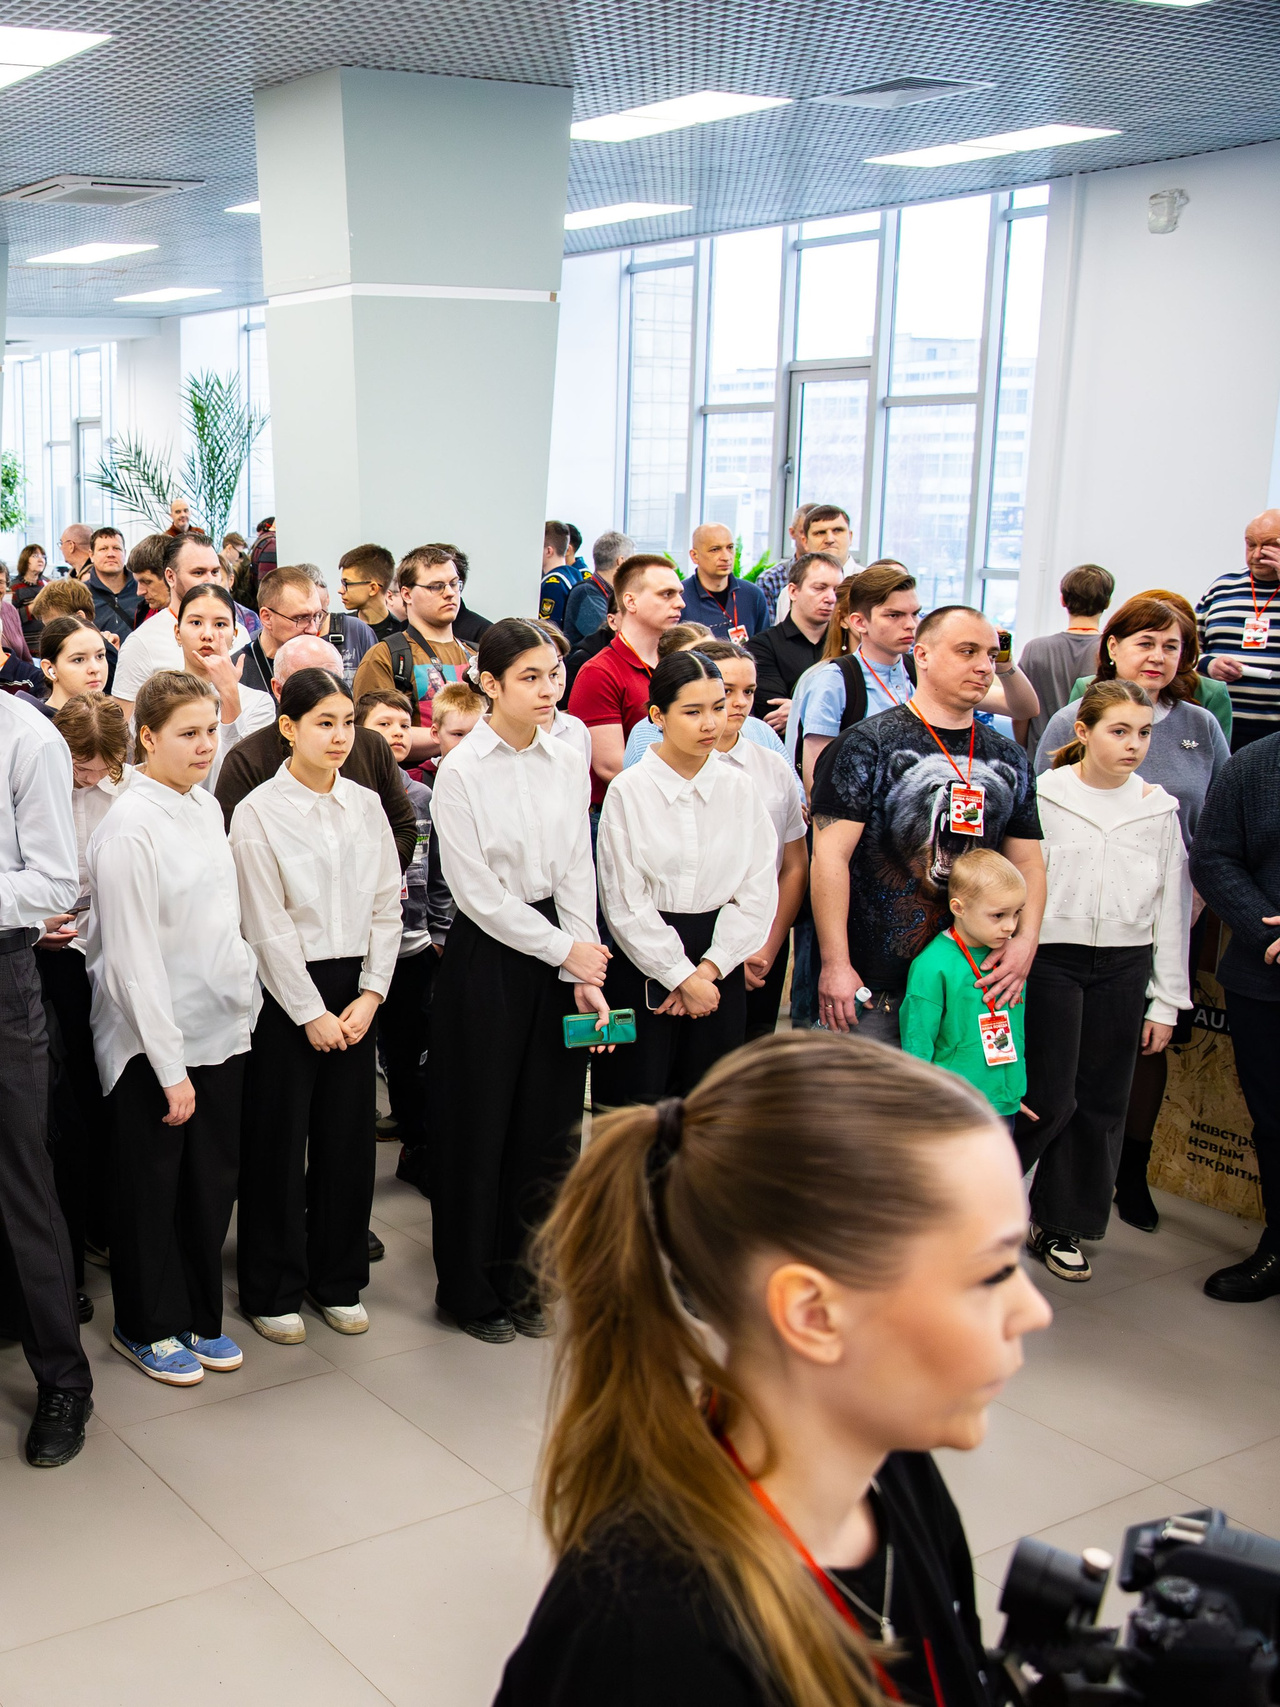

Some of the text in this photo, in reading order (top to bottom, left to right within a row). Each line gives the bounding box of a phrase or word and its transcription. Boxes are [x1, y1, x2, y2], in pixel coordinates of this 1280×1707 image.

[1194, 1008, 1230, 1031] AU
[1190, 1120, 1256, 1149] навстре
[1188, 1136, 1244, 1161] новым
[1186, 1152, 1262, 1185] открыти
